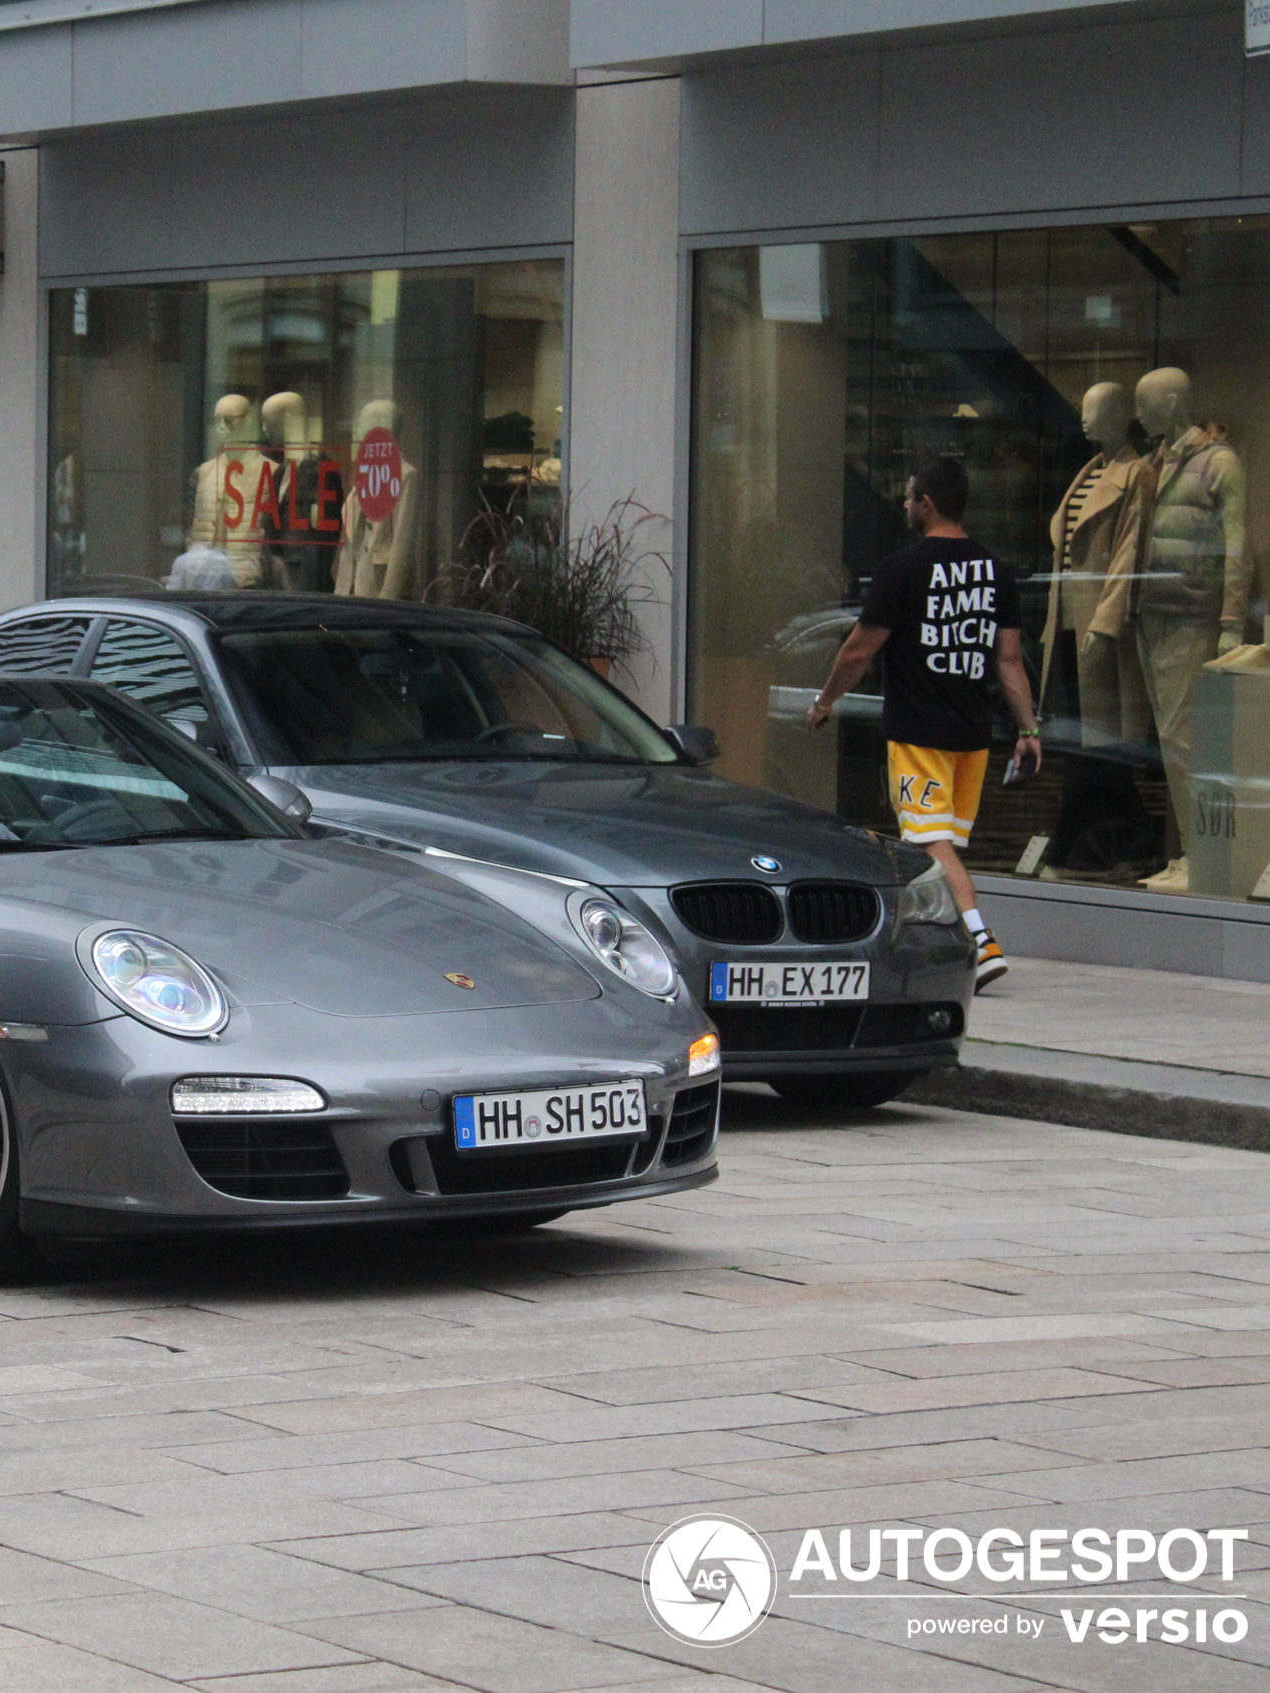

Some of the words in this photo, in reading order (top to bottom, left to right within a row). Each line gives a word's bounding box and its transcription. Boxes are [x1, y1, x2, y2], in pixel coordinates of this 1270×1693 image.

[363, 442, 394, 458] JETZT
[223, 459, 342, 531] SALE
[359, 463, 400, 498] 70%
[929, 559, 995, 589] ANTI
[926, 586, 996, 619] FAME
[920, 618, 998, 649] BITCH
[715, 984, 723, 995] D
[728, 967, 764, 997] HH
[462, 1127, 470, 1139] D
[478, 1099, 523, 1140] HH
